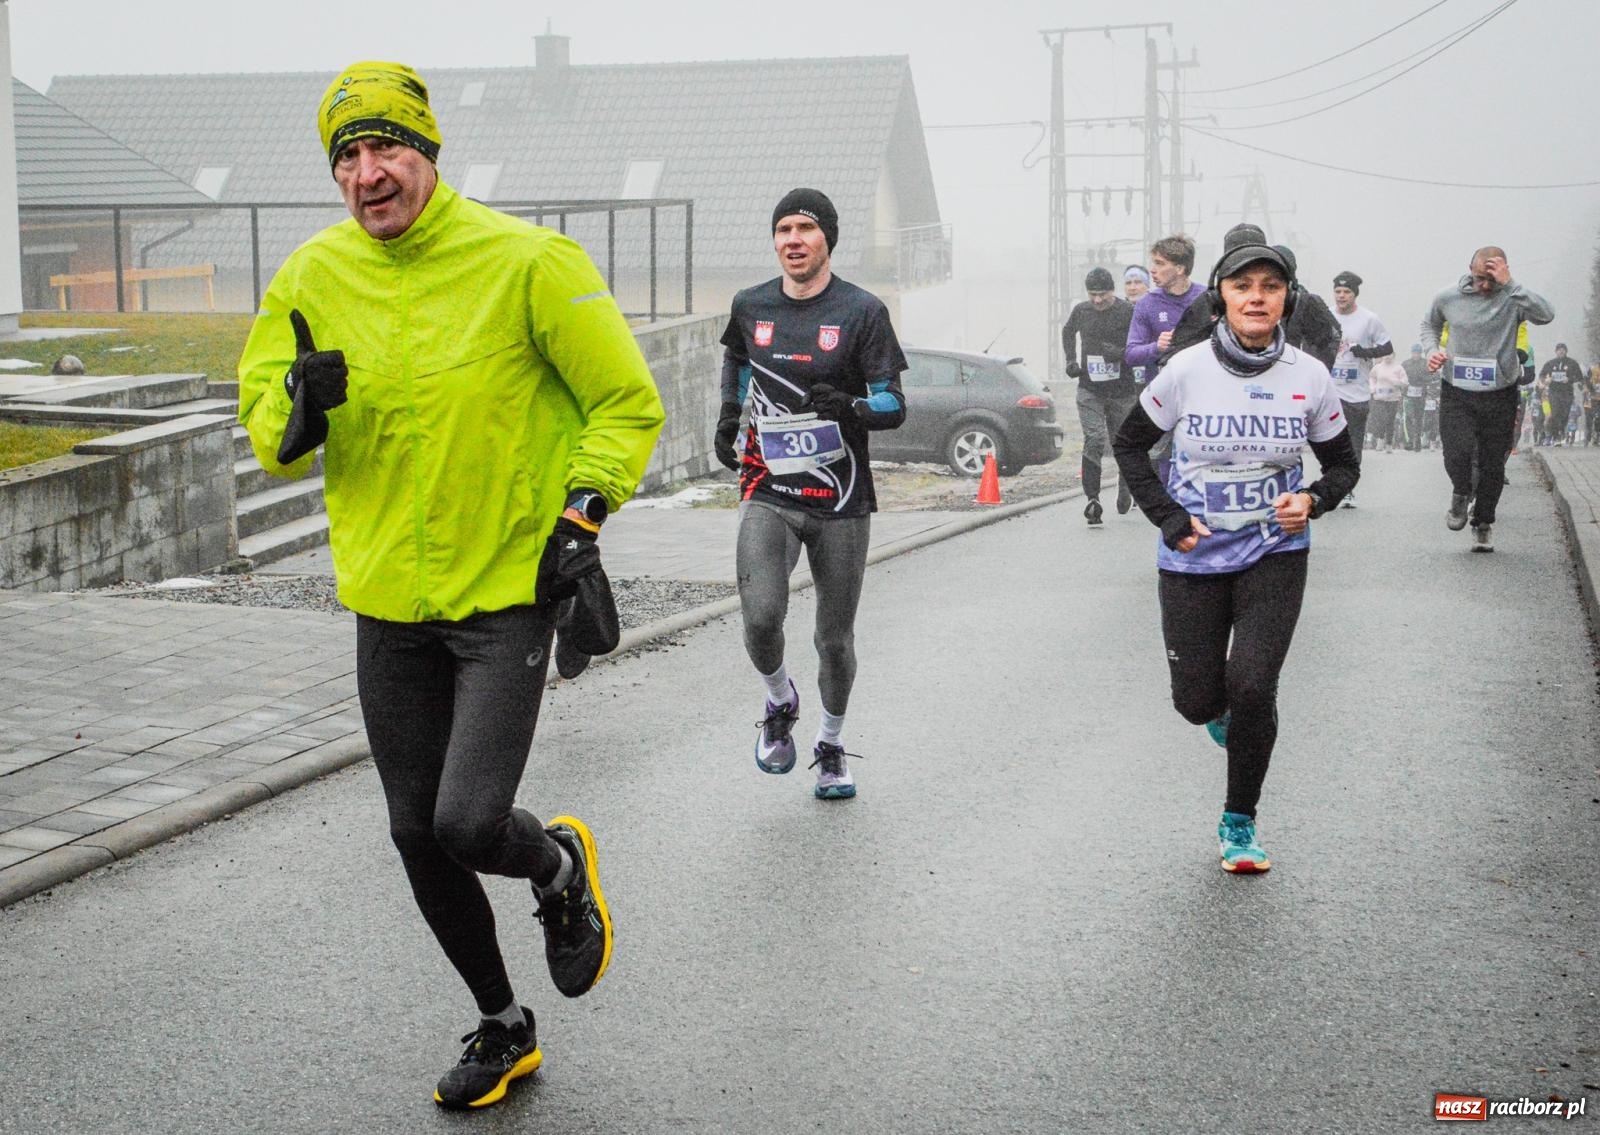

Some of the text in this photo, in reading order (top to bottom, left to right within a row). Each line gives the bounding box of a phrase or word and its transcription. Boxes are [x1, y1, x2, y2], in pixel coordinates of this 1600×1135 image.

[1092, 362, 1114, 375] 182
[1465, 367, 1483, 380] 85
[783, 431, 818, 456] 30
[1201, 444, 1266, 454] EKO-OKNA
[1222, 477, 1279, 511] 150
